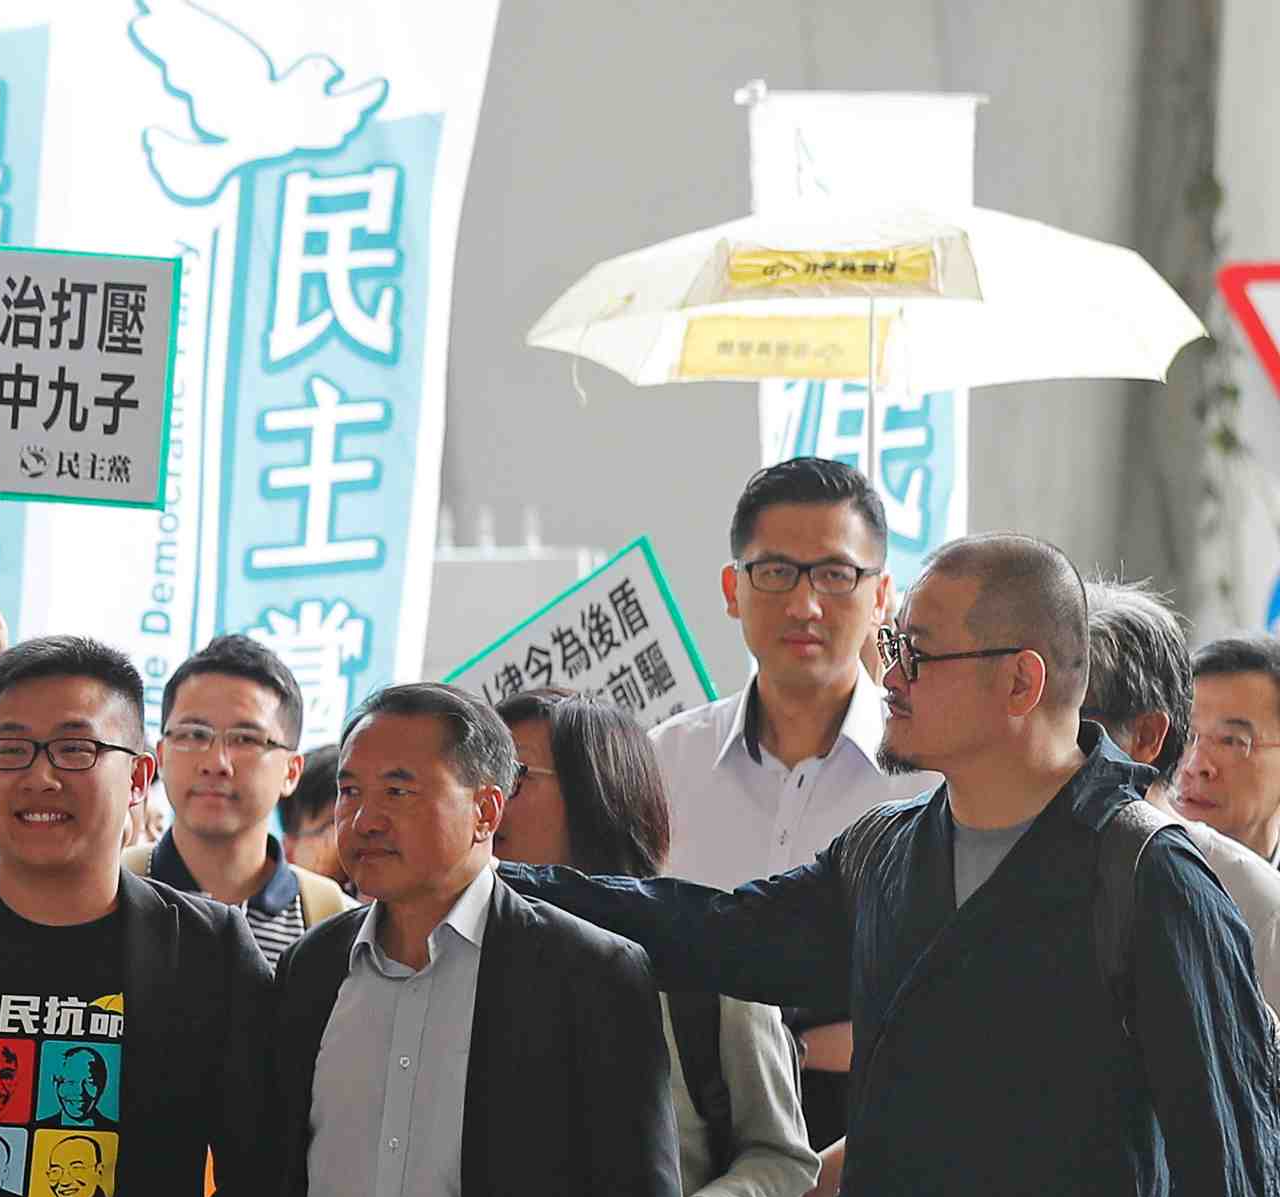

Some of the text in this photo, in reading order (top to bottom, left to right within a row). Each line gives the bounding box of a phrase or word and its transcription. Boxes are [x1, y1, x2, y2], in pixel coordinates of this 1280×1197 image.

[55, 450, 132, 483] 民主黨
[482, 577, 649, 702] 律令為後盾
